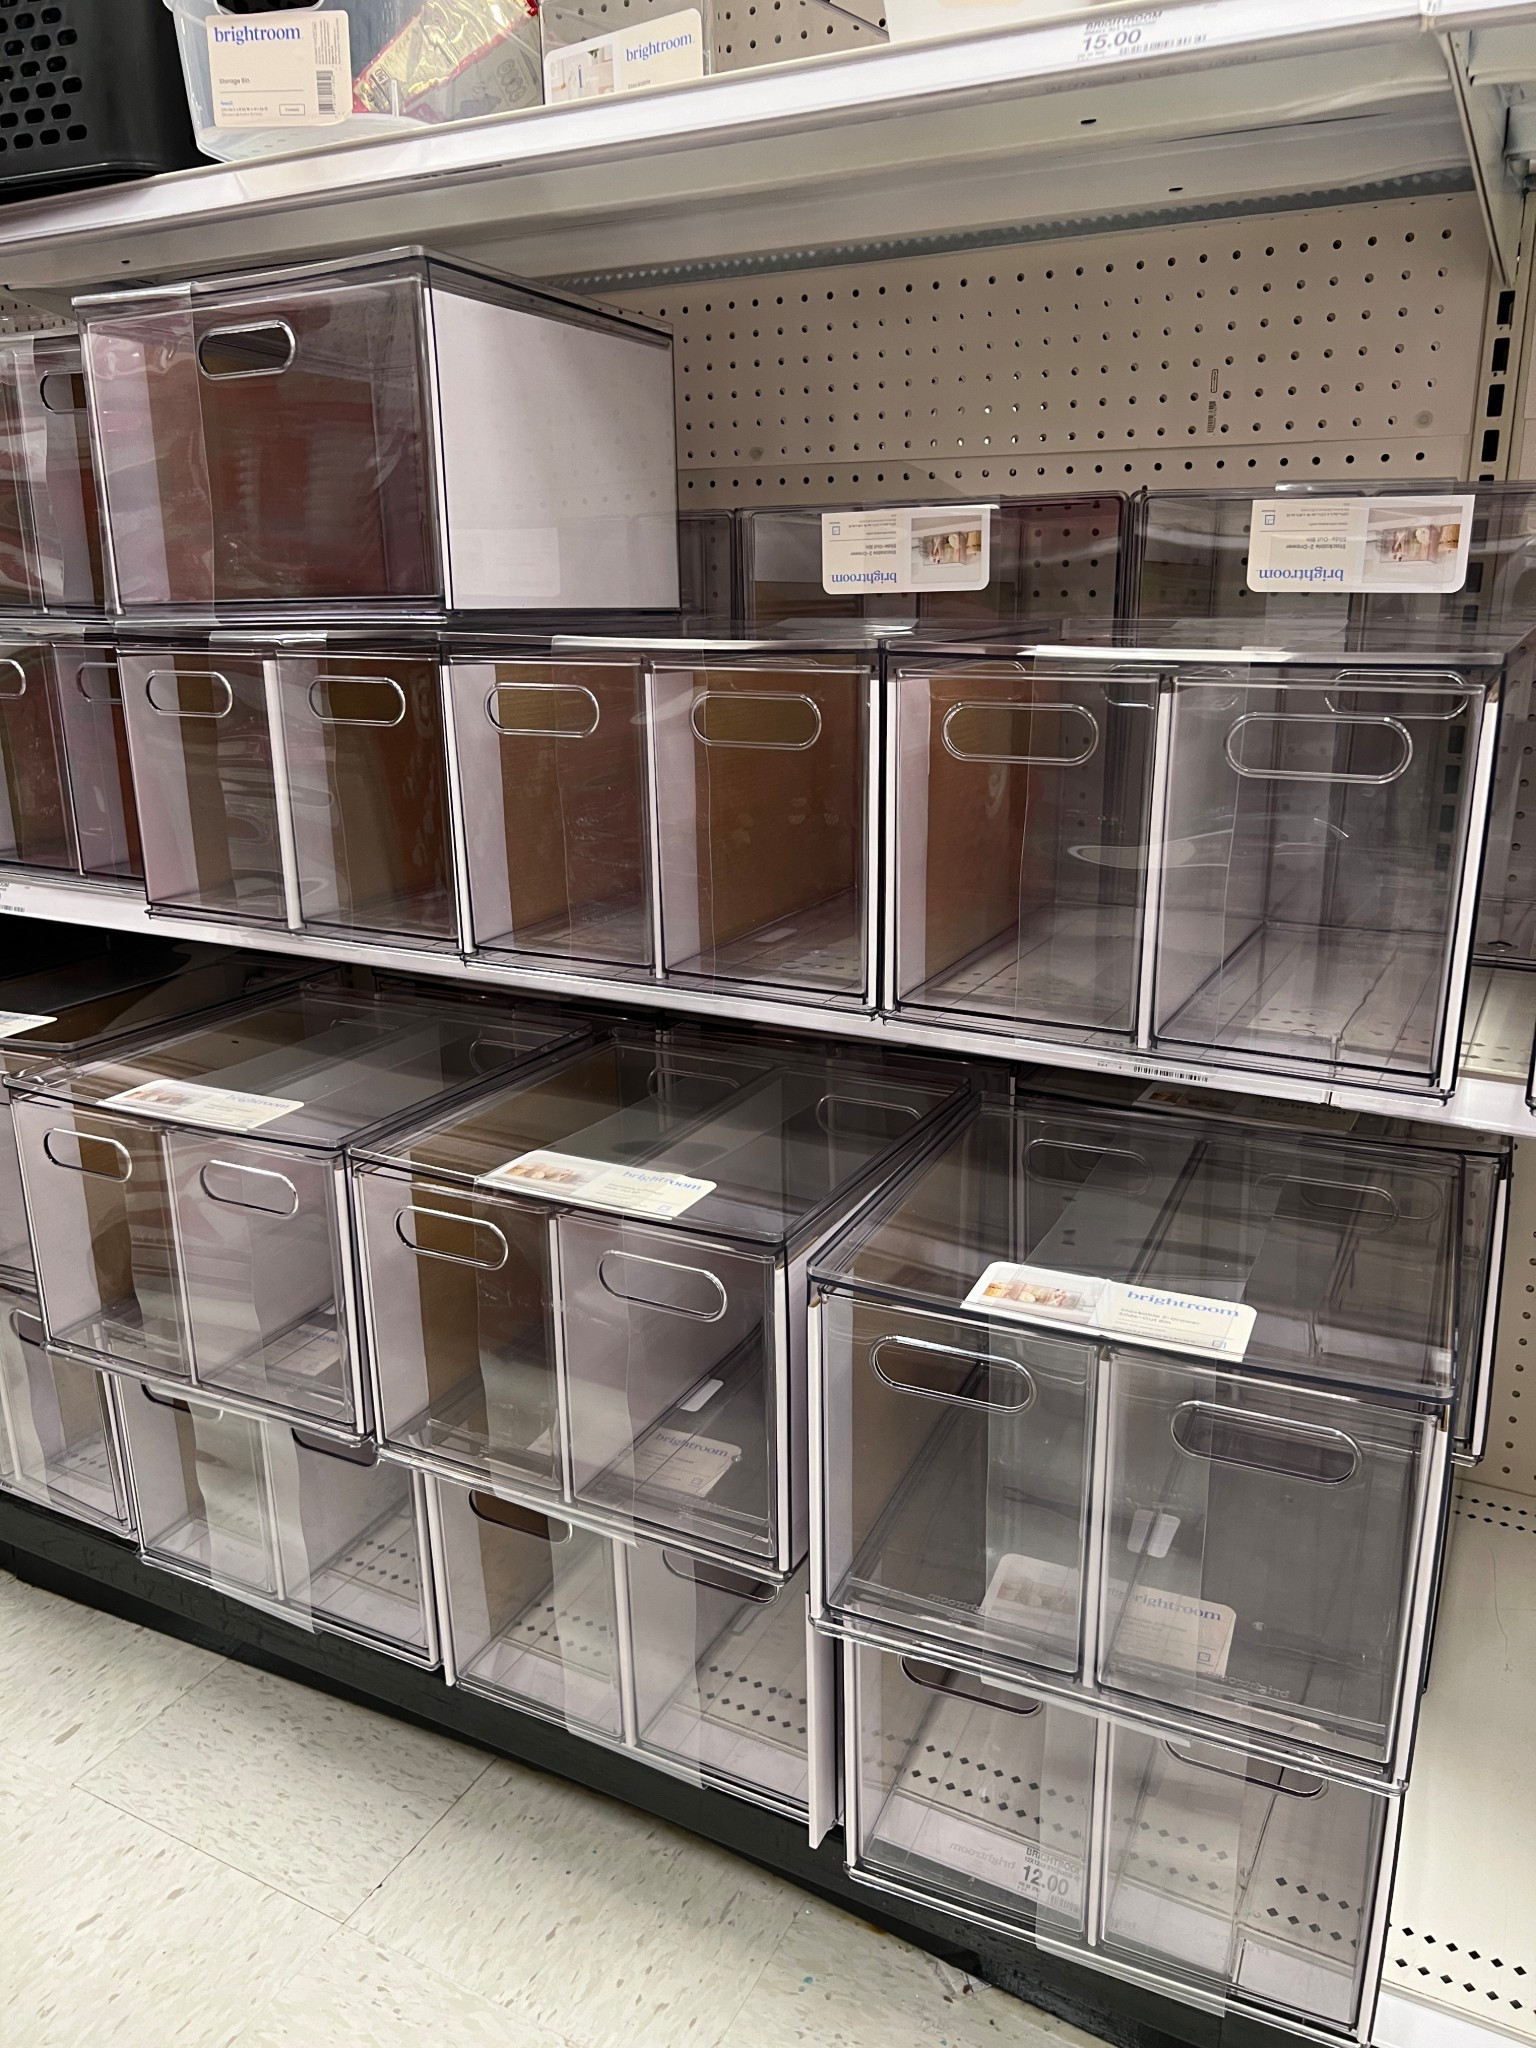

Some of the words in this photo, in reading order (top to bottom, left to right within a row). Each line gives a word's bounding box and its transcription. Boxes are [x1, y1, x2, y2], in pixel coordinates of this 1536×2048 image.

[213, 26, 301, 46] brightroom
[626, 33, 692, 62] brightroom
[1083, 28, 1142, 52] 15.00
[831, 570, 897, 584] brightroom
[1259, 566, 1344, 582] brightroom
[622, 1170, 702, 1191] brightroom
[1127, 1290, 1239, 1317] brightroom
[655, 1432, 729, 1458] brightroom
[1133, 1594, 1221, 1621] rightroom
[1023, 1865, 1070, 1896] 12.00
